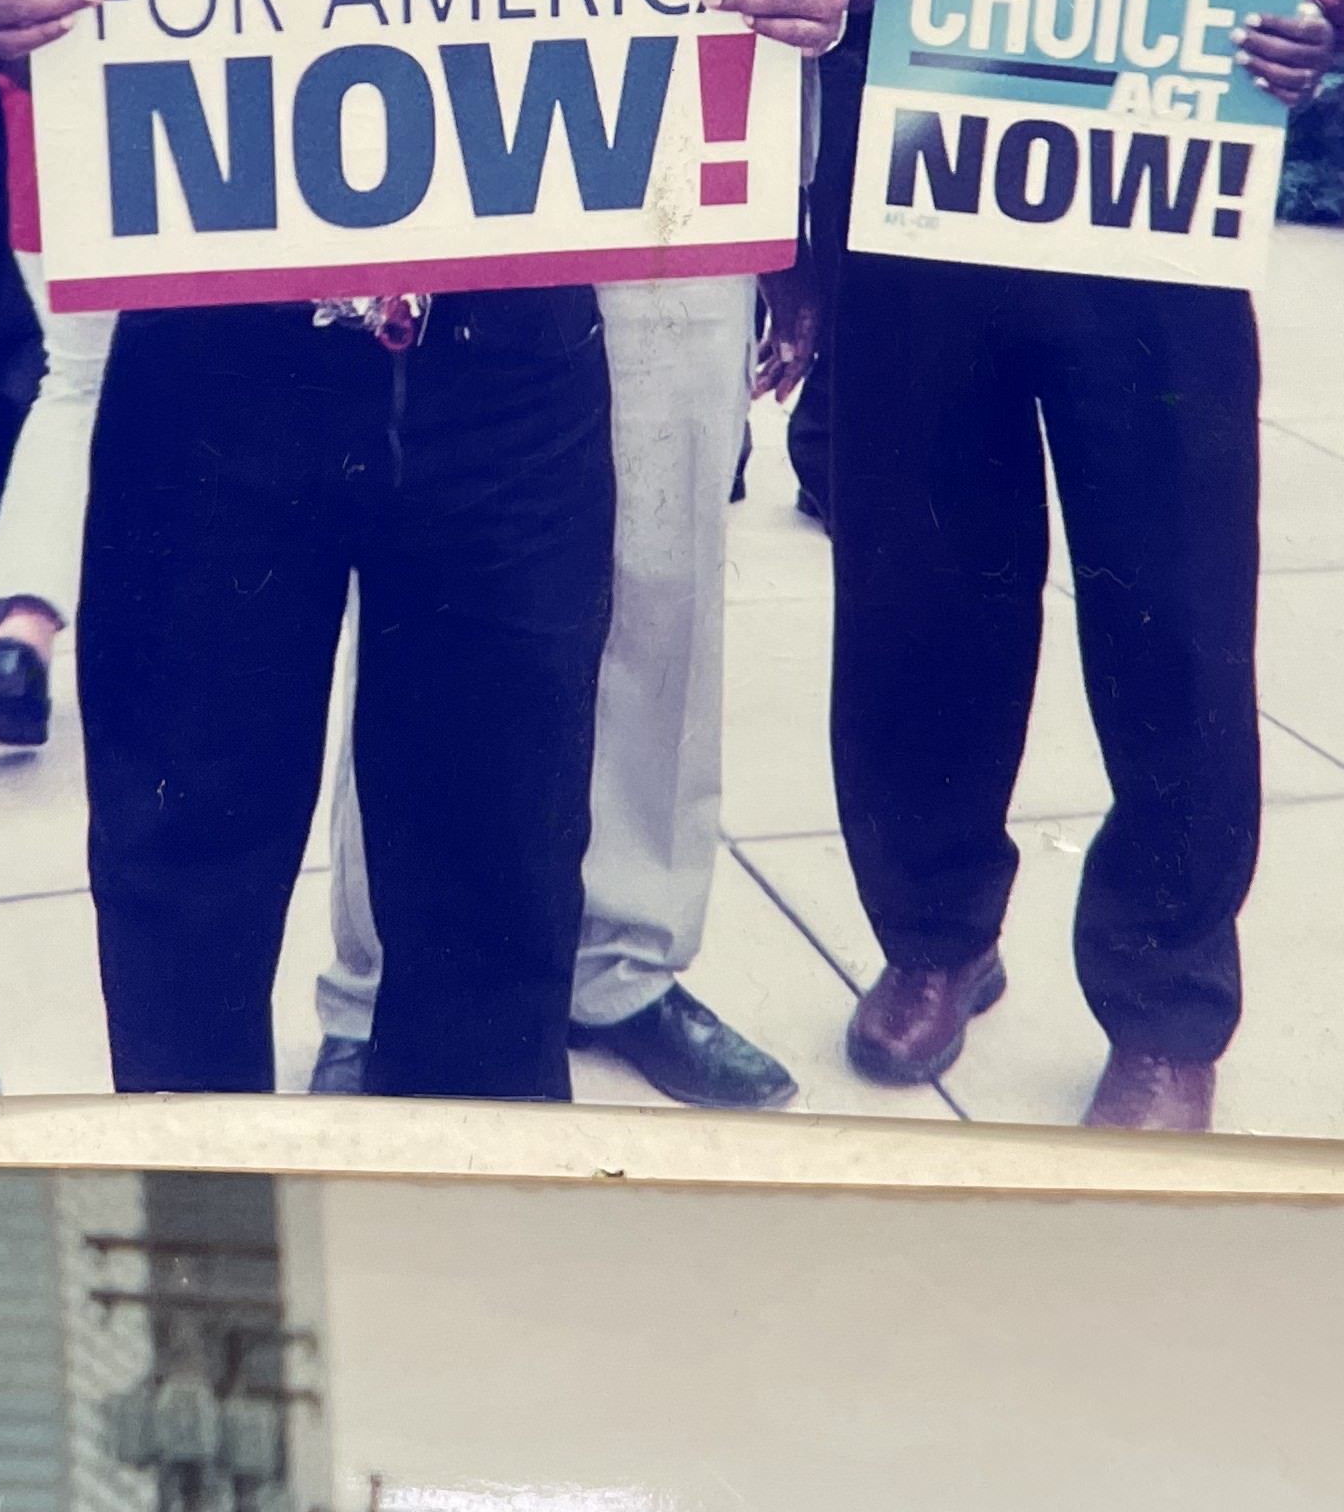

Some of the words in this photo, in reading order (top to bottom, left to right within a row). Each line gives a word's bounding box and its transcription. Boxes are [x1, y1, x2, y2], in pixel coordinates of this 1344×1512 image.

[103, 33, 757, 237] NOW!
[1106, 71, 1229, 123] ACT
[885, 107, 1255, 239] NOW!
